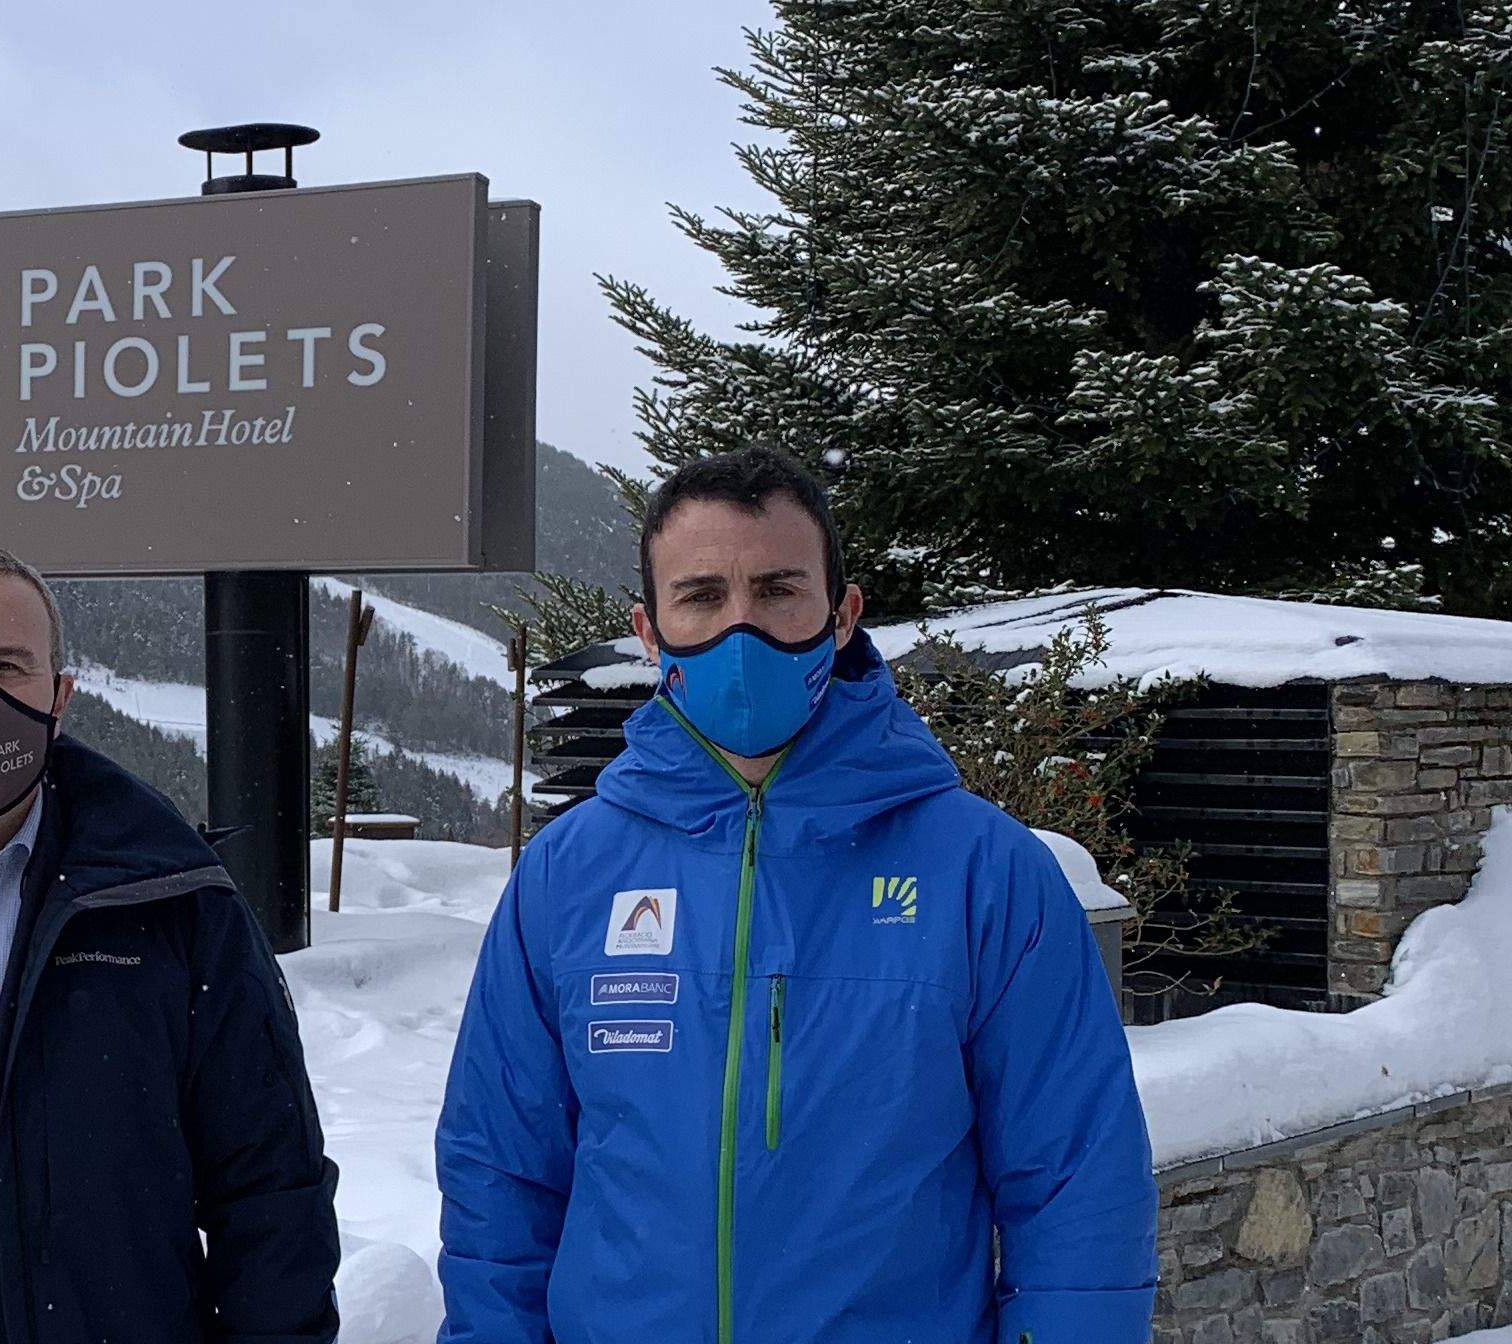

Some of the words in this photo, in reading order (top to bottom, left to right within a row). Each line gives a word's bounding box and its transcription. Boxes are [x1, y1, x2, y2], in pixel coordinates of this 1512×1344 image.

[21, 256, 237, 327] PARK
[20, 323, 386, 401] PIOLETS
[608, 982, 672, 994] MORABANC
[593, 1028, 663, 1045] Viladomat
